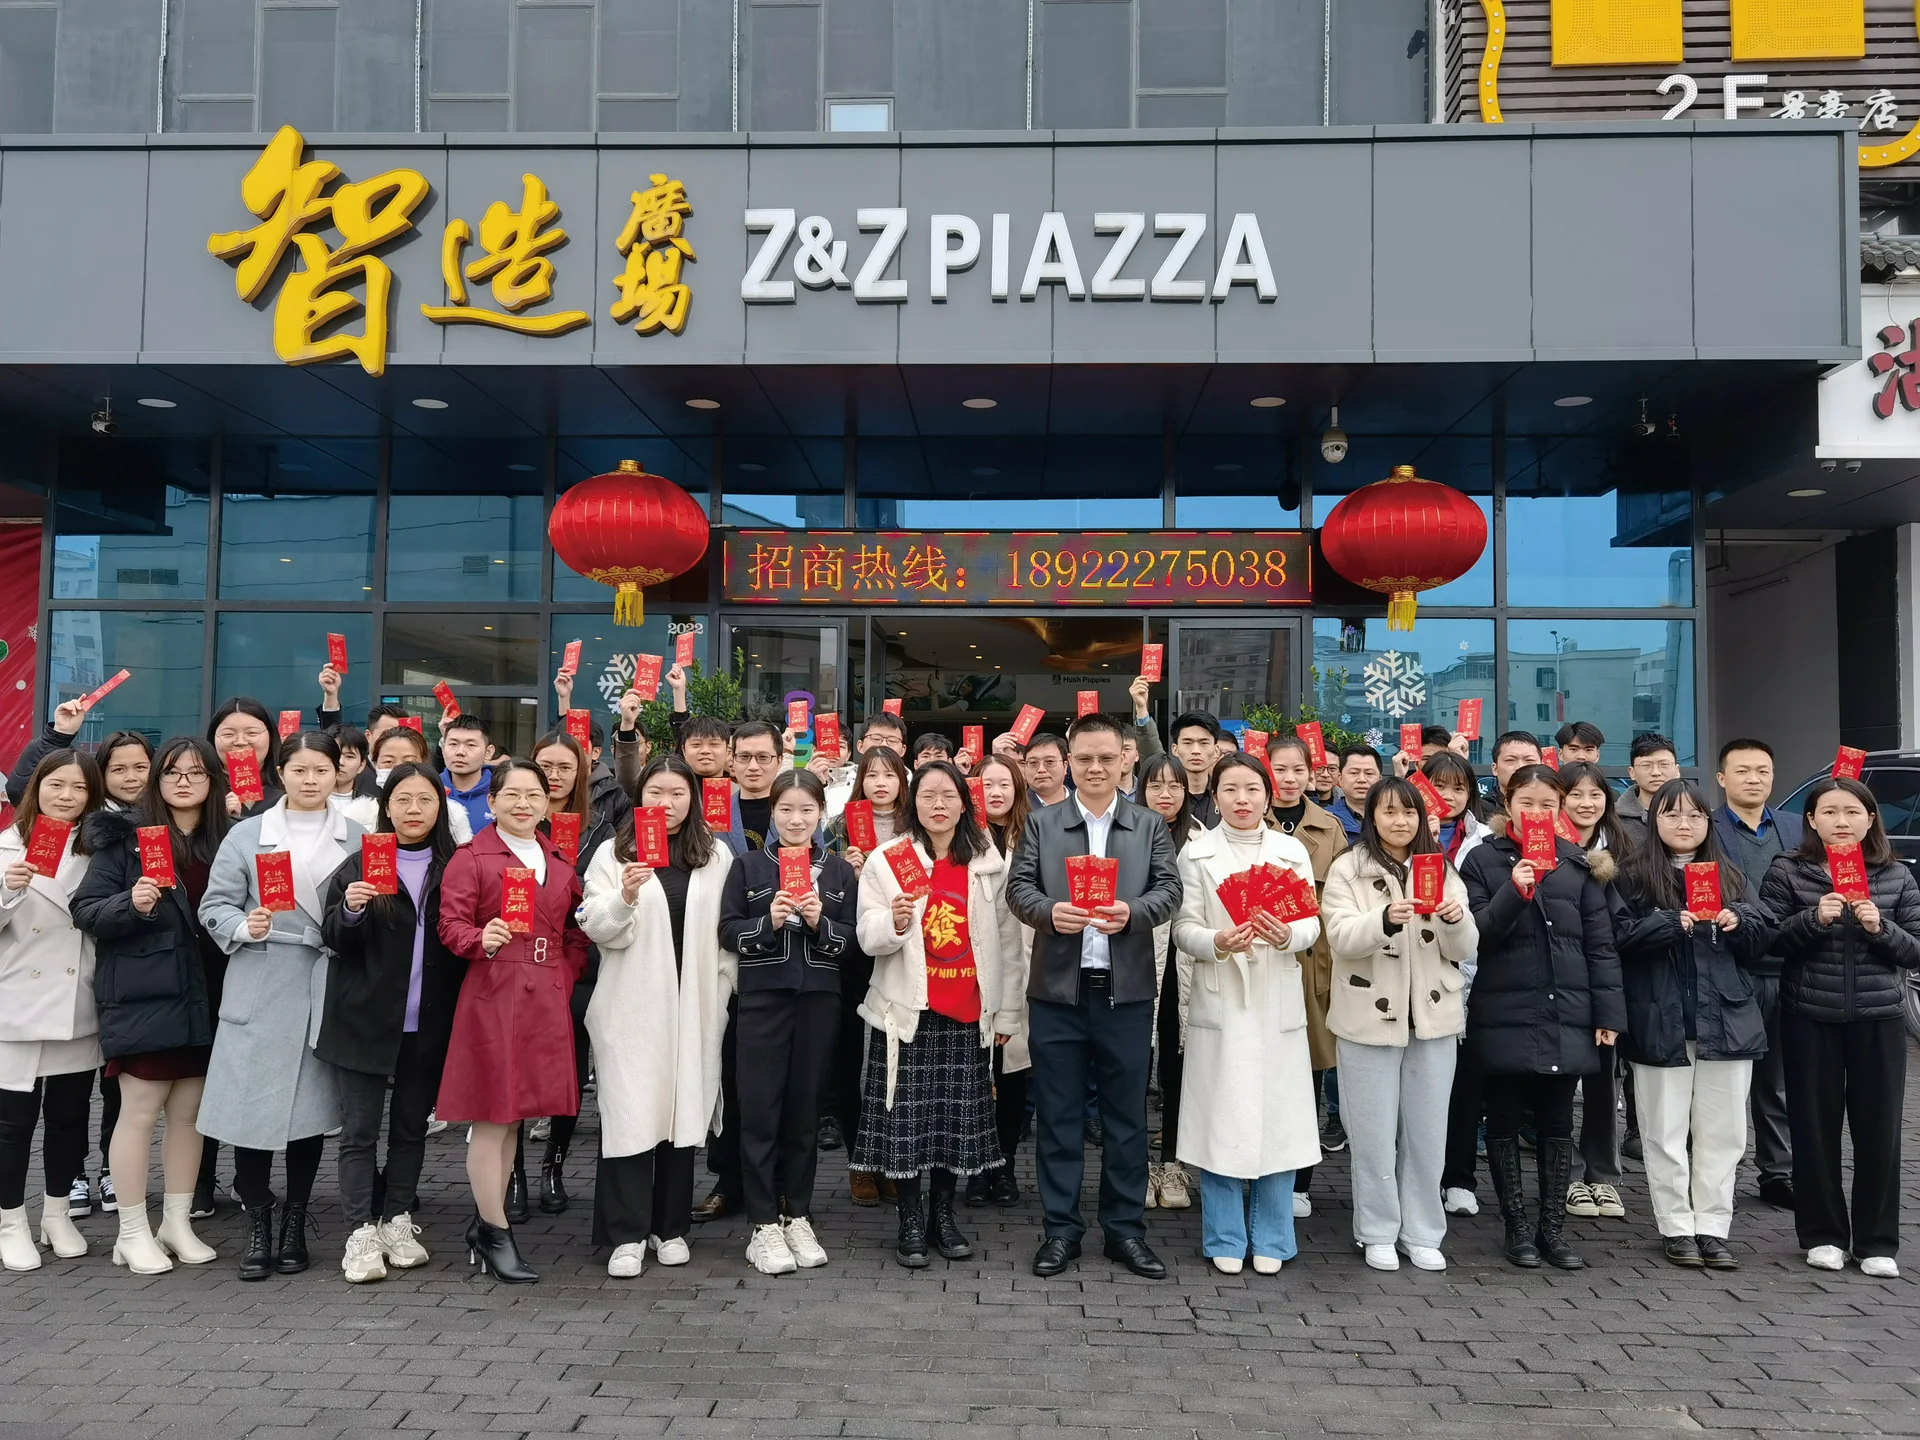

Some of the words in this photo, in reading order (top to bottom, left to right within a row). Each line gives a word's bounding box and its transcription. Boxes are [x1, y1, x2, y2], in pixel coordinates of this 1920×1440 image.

[741, 207, 908, 303] Z&Z
[930, 211, 1279, 302] PIAZZA
[1006, 549, 1287, 589] 18922275038
[668, 622, 704, 635] 2022
[923, 900, 968, 950] 發
[939, 968, 957, 979] NIU
